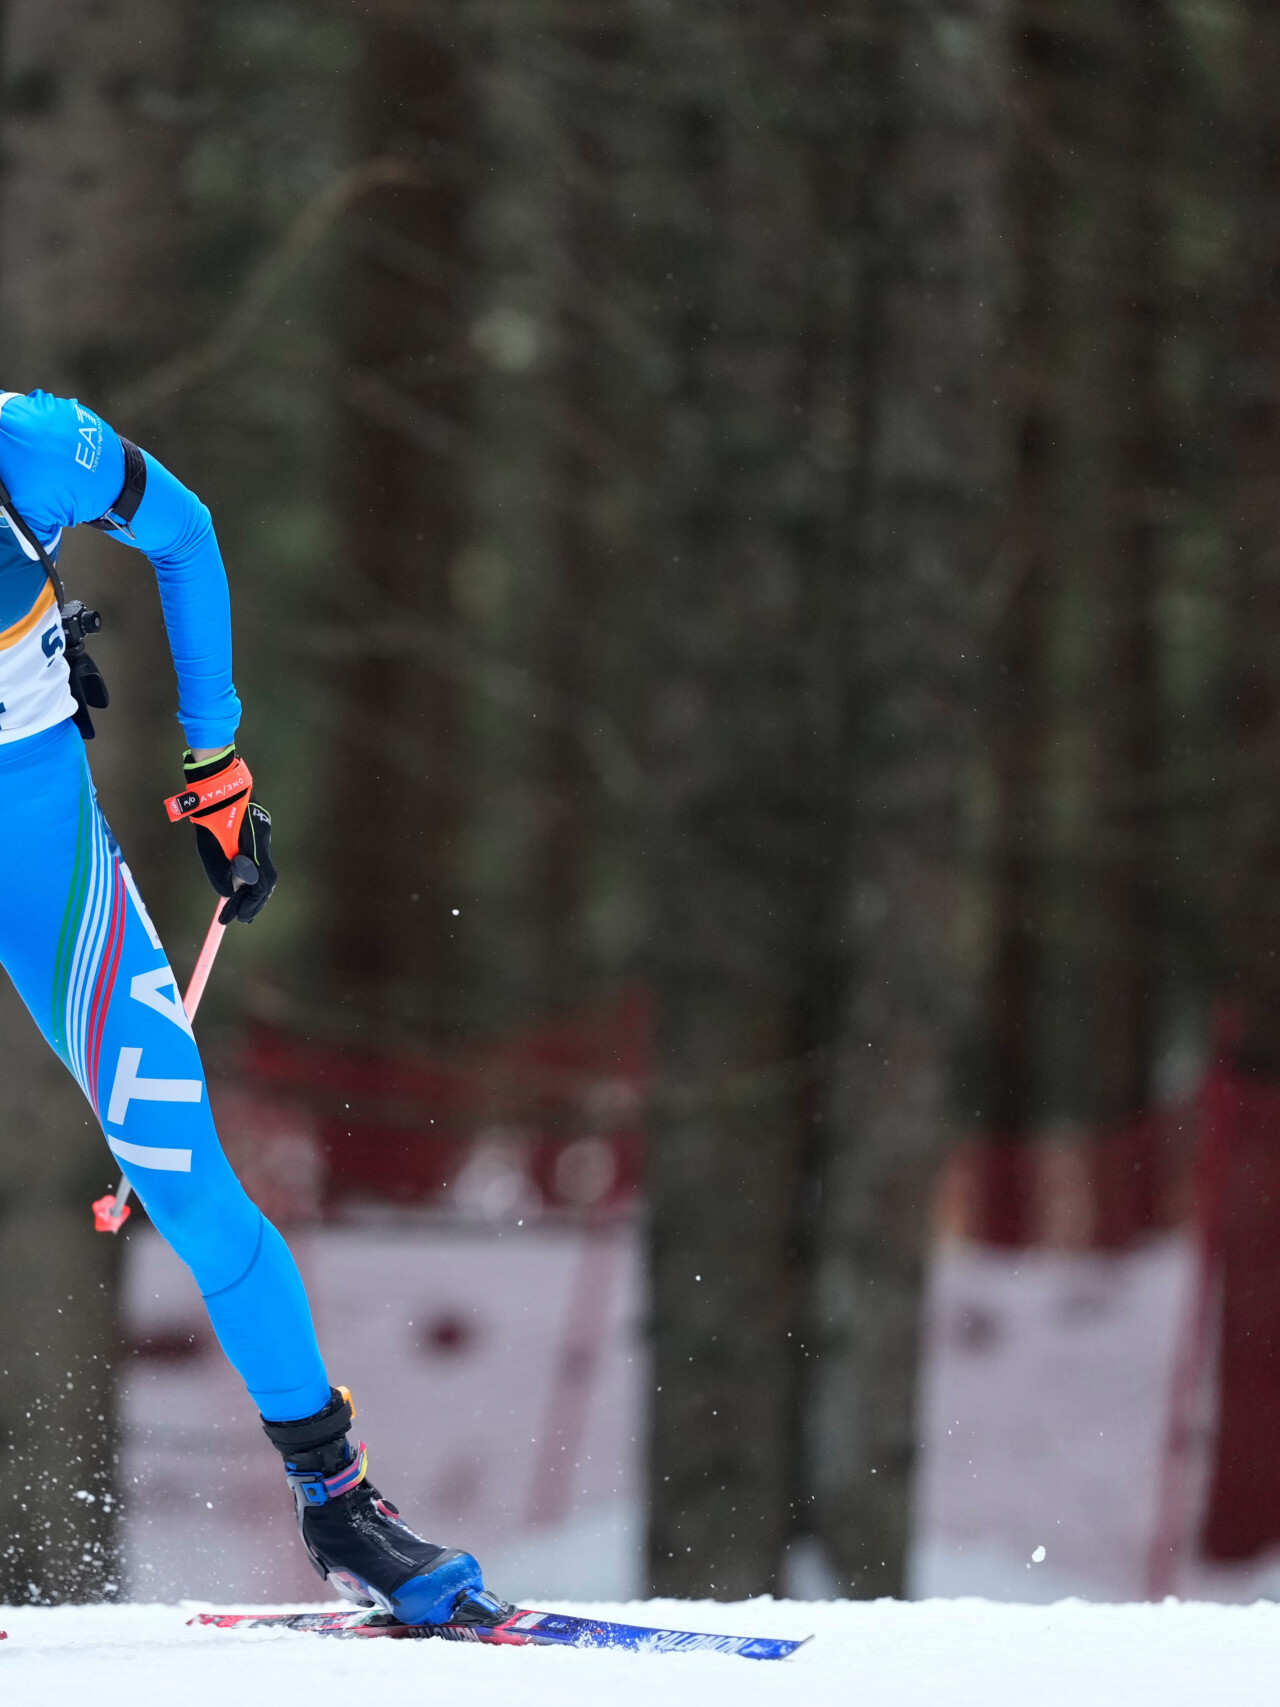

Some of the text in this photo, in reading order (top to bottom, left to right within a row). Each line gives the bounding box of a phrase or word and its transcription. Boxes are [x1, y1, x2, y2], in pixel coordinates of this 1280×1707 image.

[74, 403, 98, 470] EA7
[107, 966, 203, 1163] ITA
[649, 1630, 756, 1655] SALOMON
